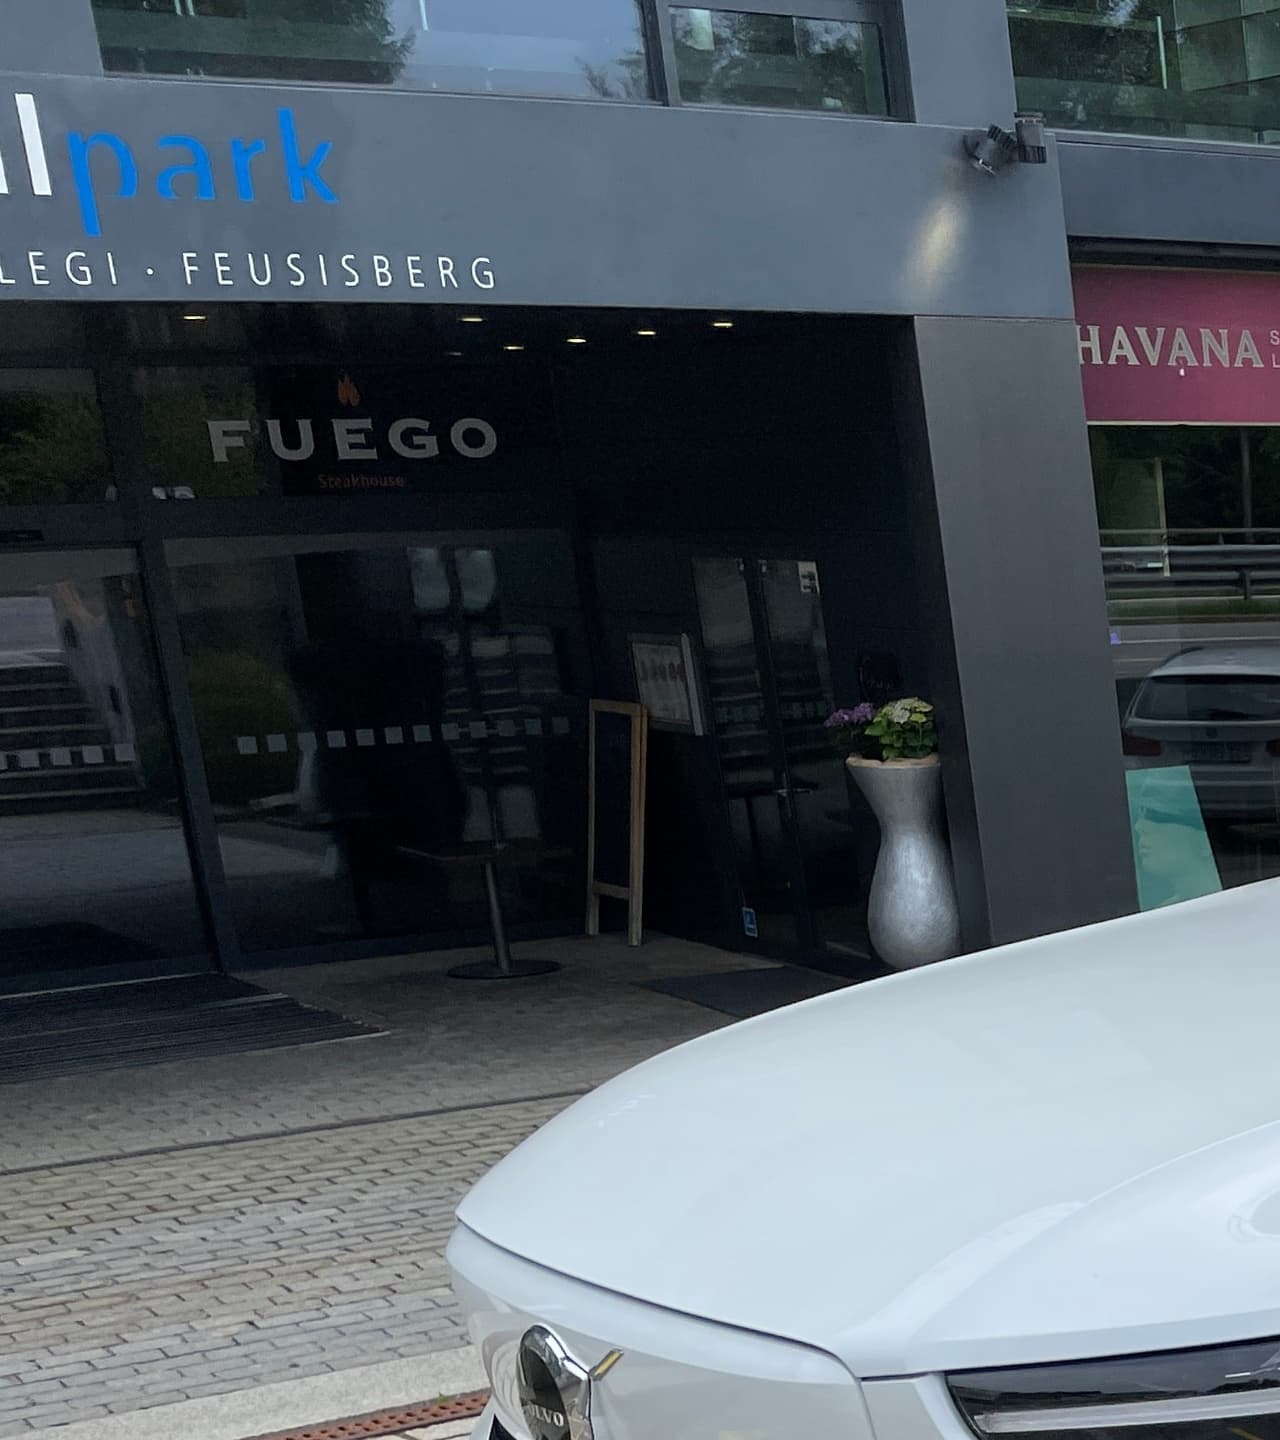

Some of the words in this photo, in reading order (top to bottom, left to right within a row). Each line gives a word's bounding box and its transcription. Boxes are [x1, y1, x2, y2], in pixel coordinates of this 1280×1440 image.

[0, 93, 339, 237] lpark
[183, 251, 497, 290] FEUSISBERG
[1076, 325, 1265, 369] HAVANA
[206, 416, 499, 463] FUEGO
[317, 473, 406, 490] Steakhouse
